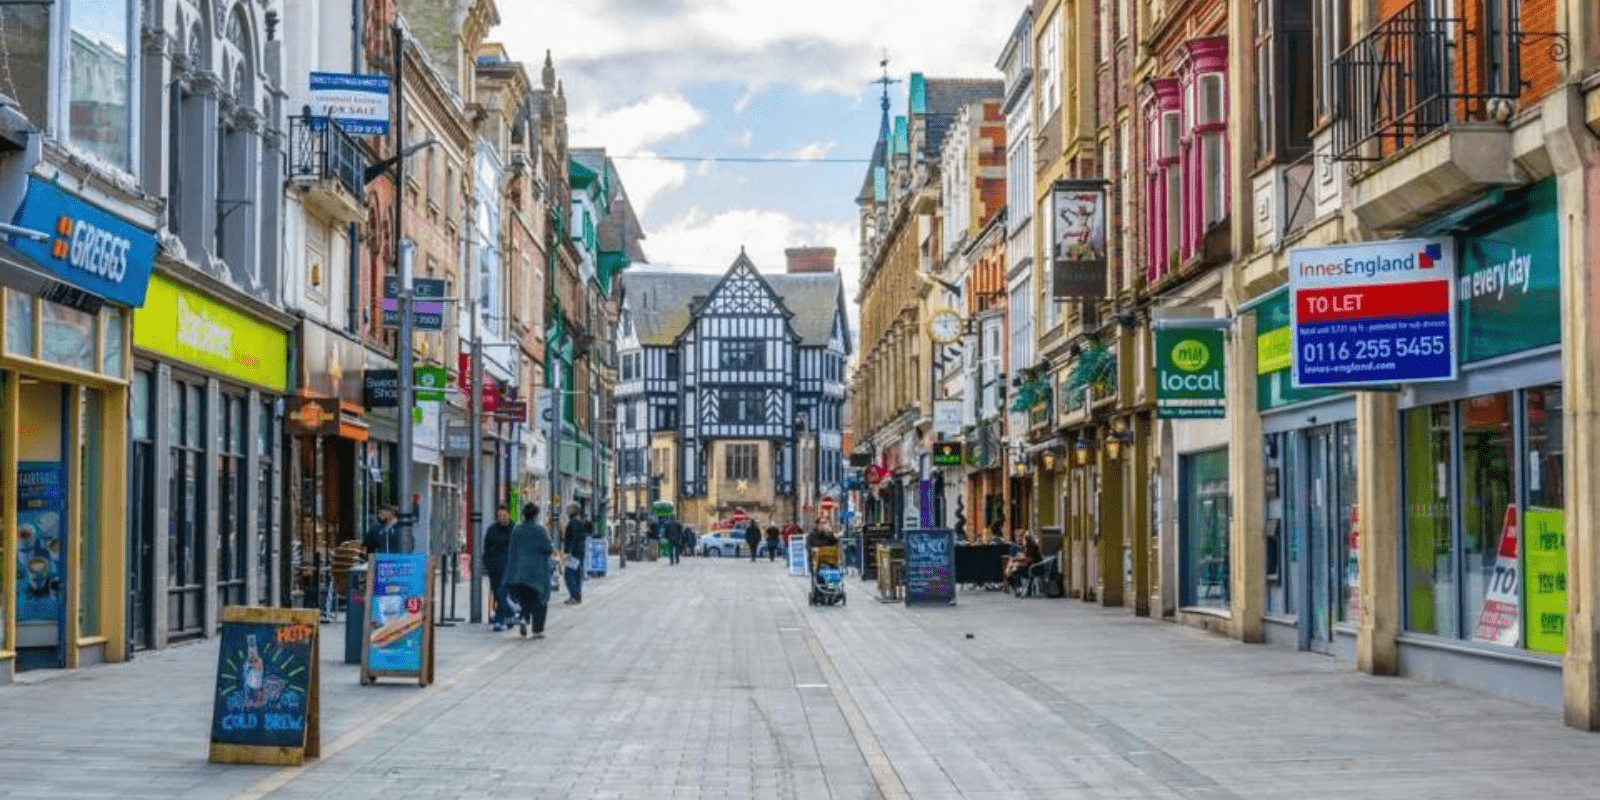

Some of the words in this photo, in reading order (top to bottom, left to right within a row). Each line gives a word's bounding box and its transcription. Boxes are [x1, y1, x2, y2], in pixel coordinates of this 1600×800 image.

[71, 219, 130, 283] GREGGS
[1472, 262, 1506, 301] every
[1507, 247, 1532, 294] day
[1306, 296, 1329, 314] TO
[1333, 293, 1364, 312] LET
[1303, 340, 1350, 362] 0116
[1355, 339, 1391, 359] 255
[1395, 335, 1445, 357] 5455
[1160, 369, 1221, 391] local
[1304, 362, 1396, 374] innes-england.com
[1493, 565, 1516, 594] TO
[222, 714, 258, 730] COLD
